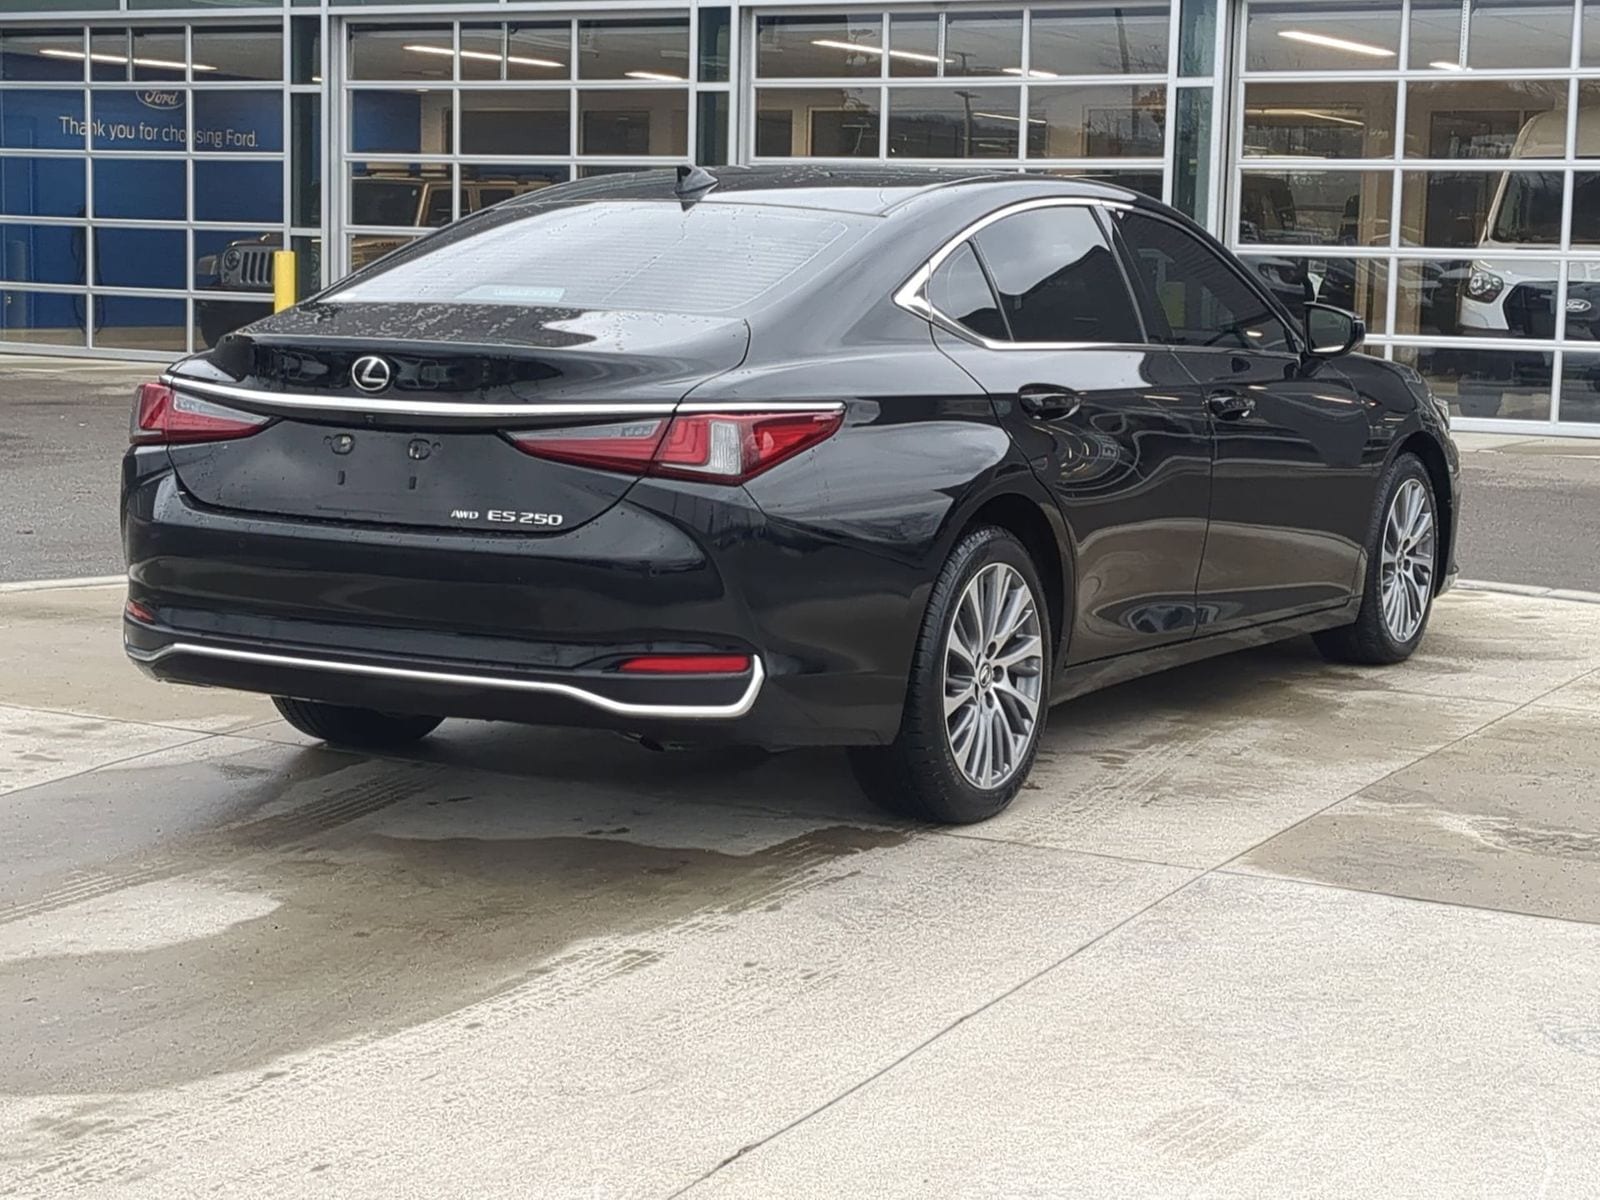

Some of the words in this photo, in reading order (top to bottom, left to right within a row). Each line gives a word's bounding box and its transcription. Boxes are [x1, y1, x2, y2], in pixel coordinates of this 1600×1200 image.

[109, 124, 135, 141] you
[139, 122, 159, 140] for
[161, 124, 223, 148] chosing
[225, 128, 259, 148] Ford.
[450, 509, 479, 520] AWD
[487, 509, 517, 523] ES
[519, 511, 564, 526] 250
